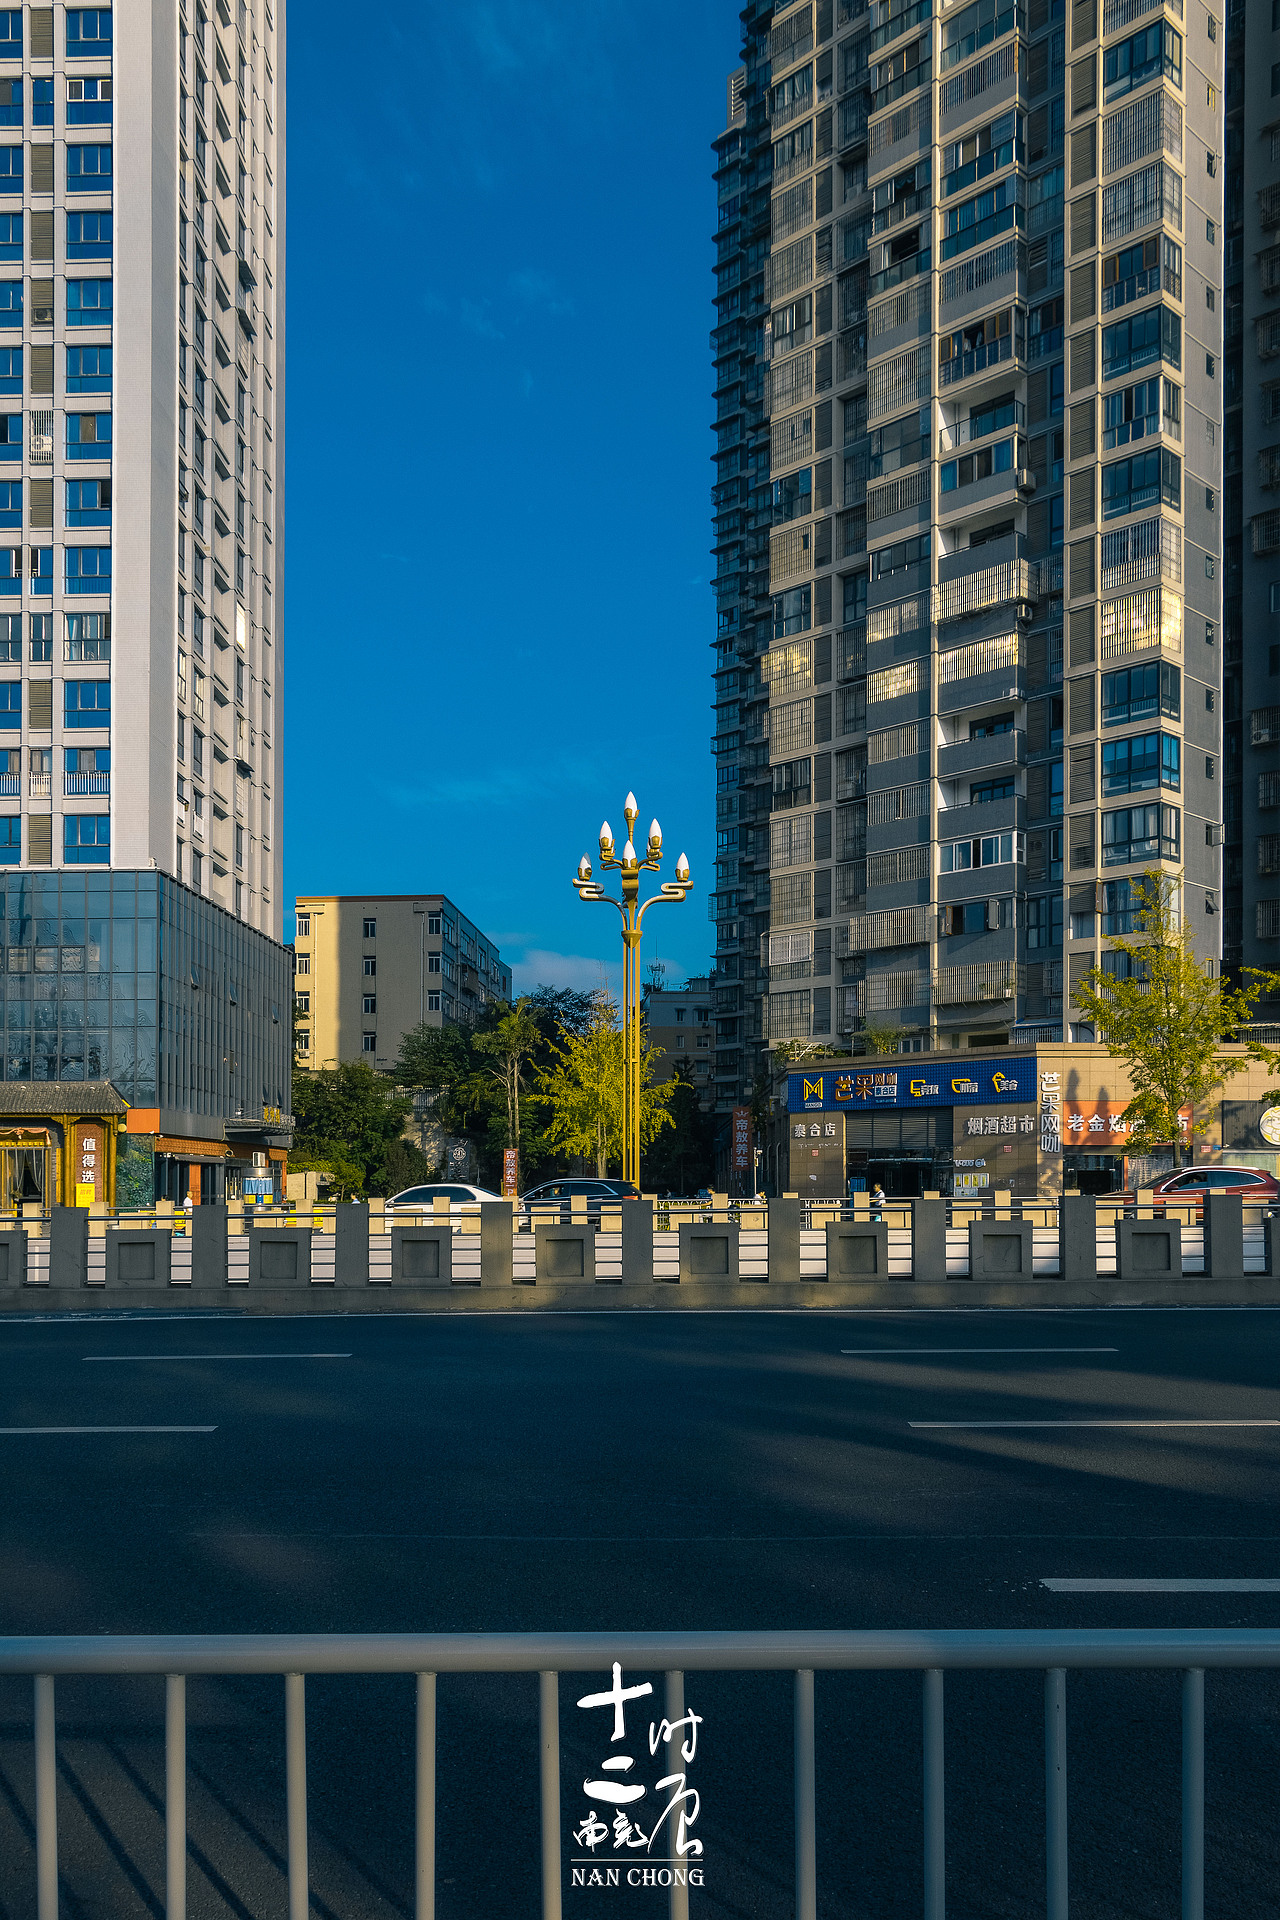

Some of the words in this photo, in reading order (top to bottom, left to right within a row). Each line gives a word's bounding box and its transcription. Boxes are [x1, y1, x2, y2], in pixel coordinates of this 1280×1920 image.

[835, 1074, 874, 1101] 芒果
[875, 1073, 898, 1085] 网咖
[875, 1086, 896, 1096] 泰合店
[968, 1115, 1034, 1136] 烟酒超市
[1041, 1072, 1061, 1152] 芒果网咖
[735, 1119, 748, 1167] 帝敖养车
[795, 1123, 836, 1137] 泰合店
[81, 1138, 96, 1183] 值得选
